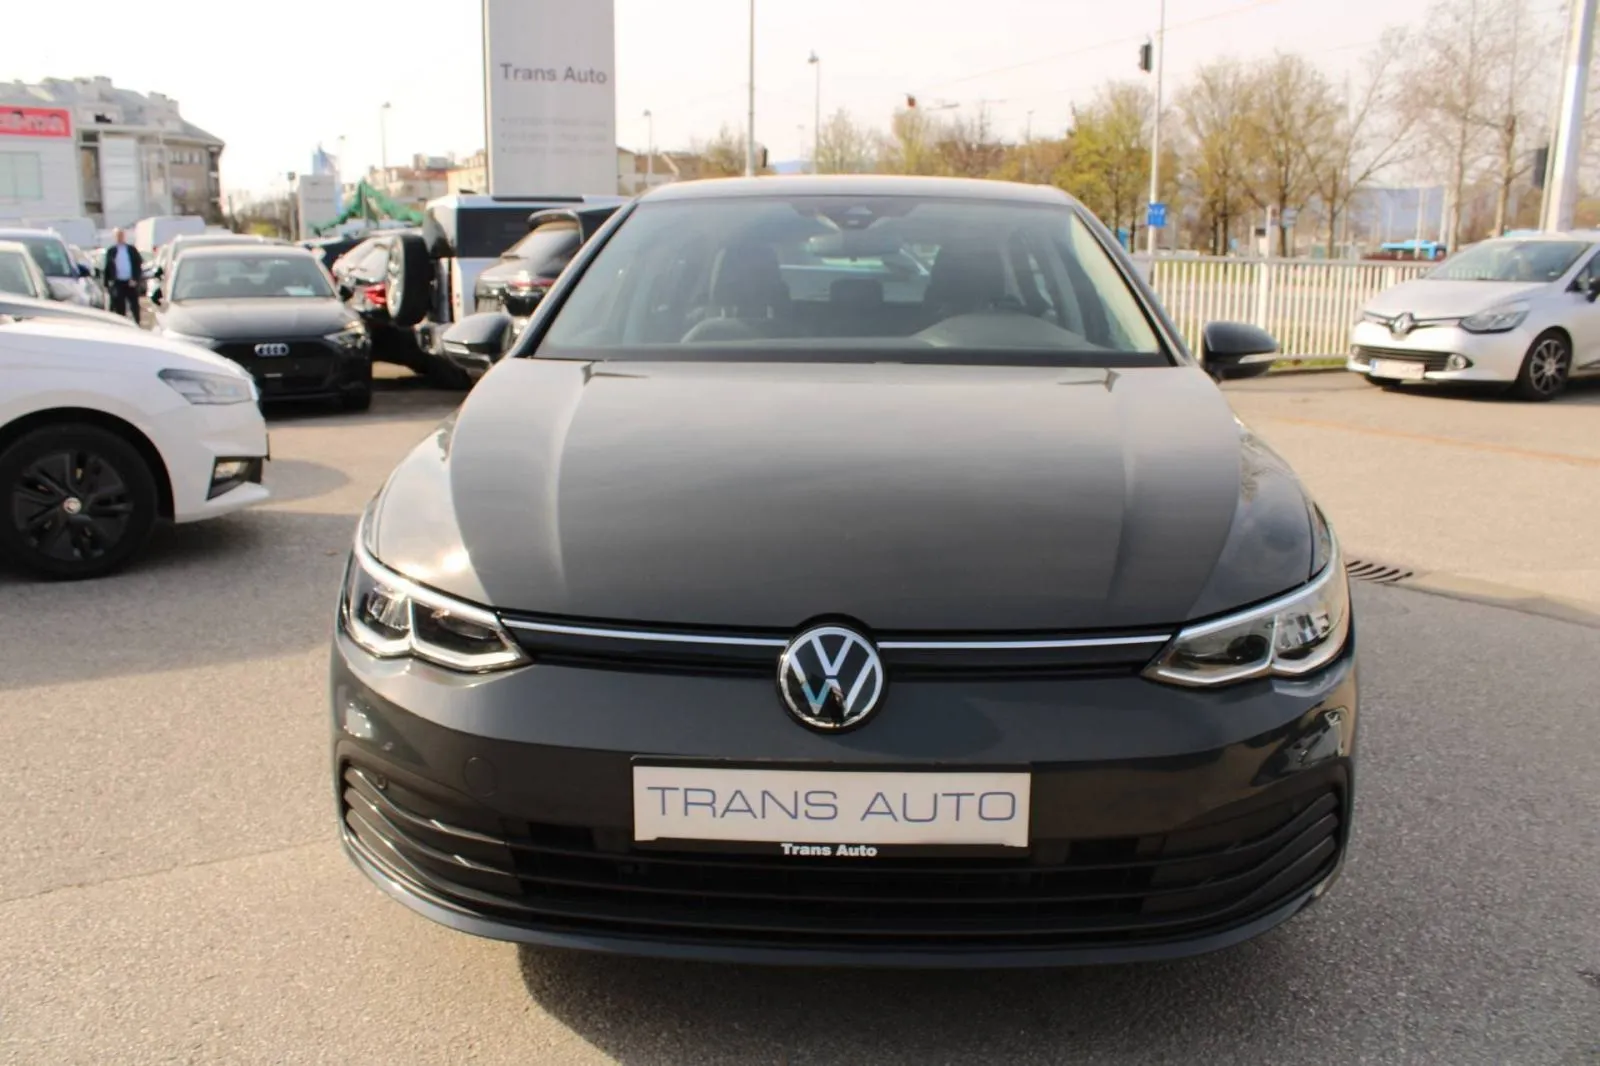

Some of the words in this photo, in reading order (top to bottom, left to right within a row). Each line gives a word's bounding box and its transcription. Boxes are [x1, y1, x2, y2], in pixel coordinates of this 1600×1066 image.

[500, 63, 557, 81] Trans
[563, 66, 608, 84] Auto
[647, 786, 839, 821] TRANS
[860, 790, 1017, 823] AUTO
[780, 842, 833, 857] Trans
[835, 844, 878, 858] Auto
